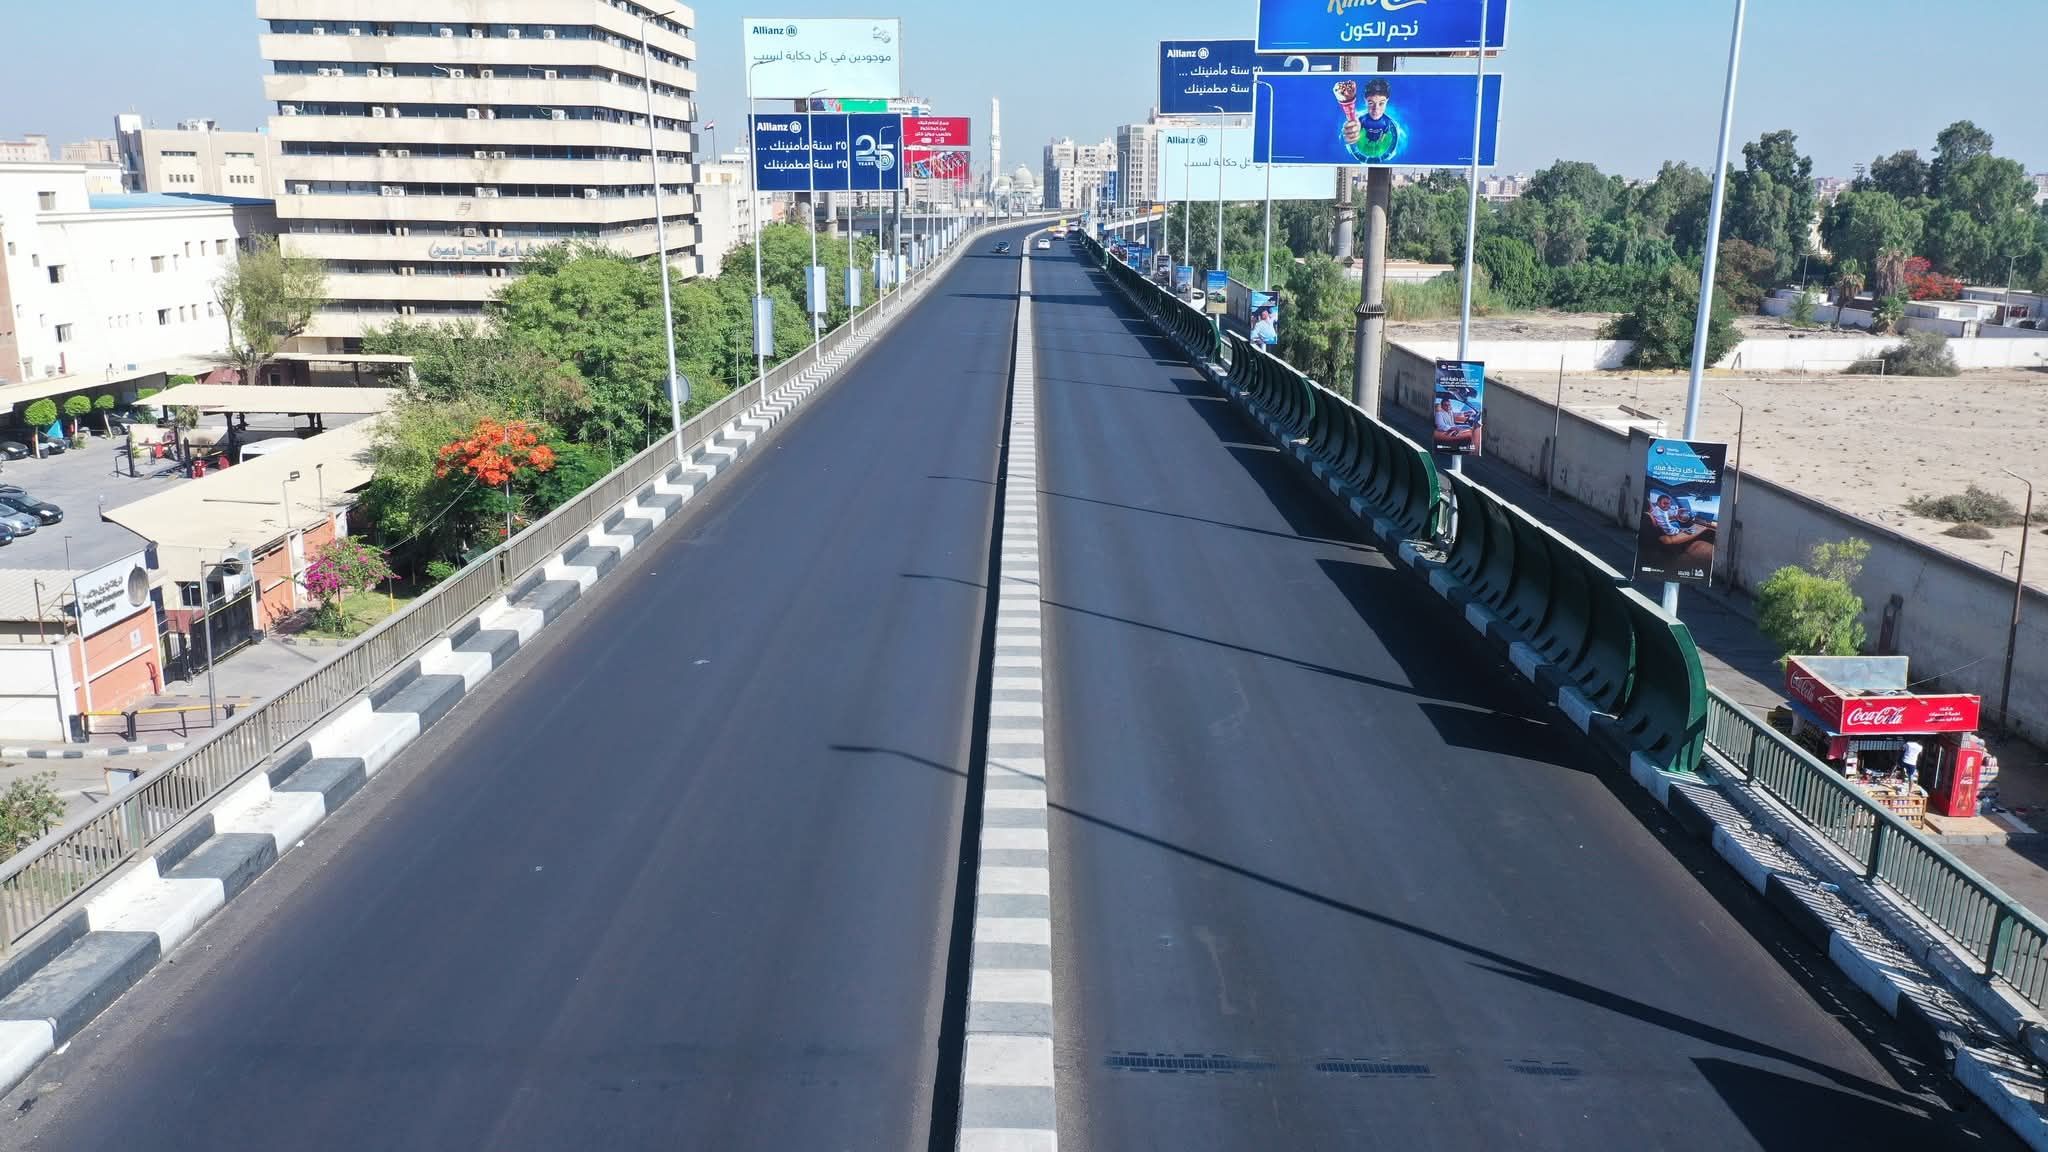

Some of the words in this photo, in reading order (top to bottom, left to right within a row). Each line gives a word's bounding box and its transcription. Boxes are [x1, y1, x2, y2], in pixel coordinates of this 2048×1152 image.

[753, 26, 784, 35] Allianz
[1341, 21, 1385, 42] الكون
[1386, 19, 1419, 42] نجم
[785, 50, 812, 63] حكاية
[814, 50, 828, 63] كل
[830, 52, 847, 66] في
[848, 52, 892, 64] موجودين
[1167, 49, 1197, 58] Allianz
[1190, 62, 1228, 78] مأمنينك
[1230, 65, 1250, 75] سنة
[1184, 83, 1228, 95] مطمنينك
[1230, 83, 1250, 93] سنة
[756, 122, 789, 132] Allianz
[769, 137, 810, 153] مأمنينك
[812, 140, 833, 151] سنة
[835, 141, 847, 150] ٢٥
[1167, 136, 1196, 145] Allianz
[855, 134, 895, 171] 25
[764, 159, 811, 172] مطمنينك
[813, 160, 834, 169] سنة
[836, 161, 848, 169] ٢٥
[1847, 706, 1907, 726] Coca-Cola
